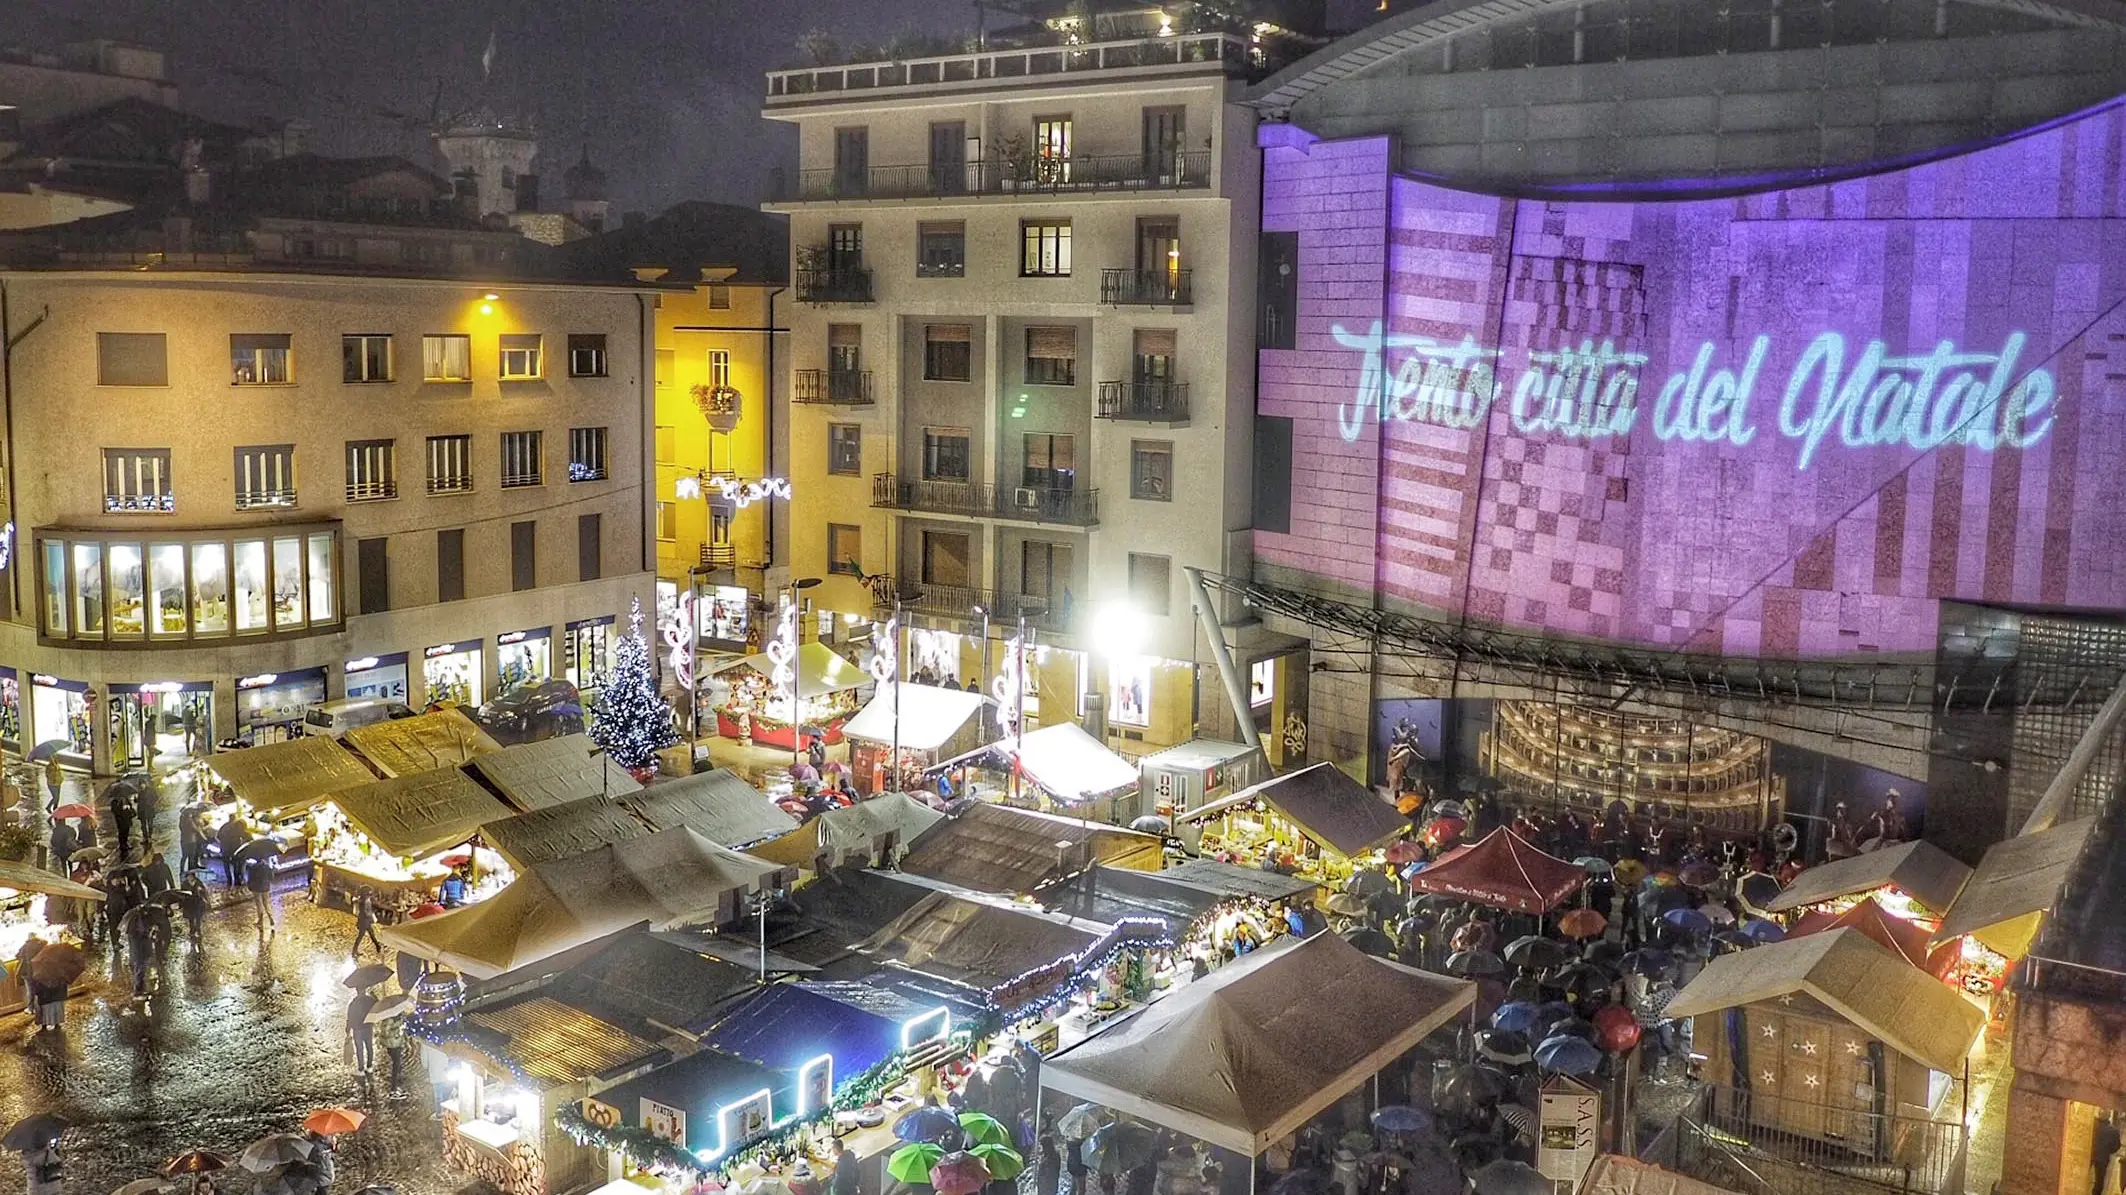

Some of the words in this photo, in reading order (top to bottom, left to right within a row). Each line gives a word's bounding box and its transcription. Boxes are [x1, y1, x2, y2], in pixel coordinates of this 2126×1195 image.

[1331, 320, 1503, 442] Trento
[1655, 334, 1768, 445] del
[1780, 332, 2055, 470] Natale
